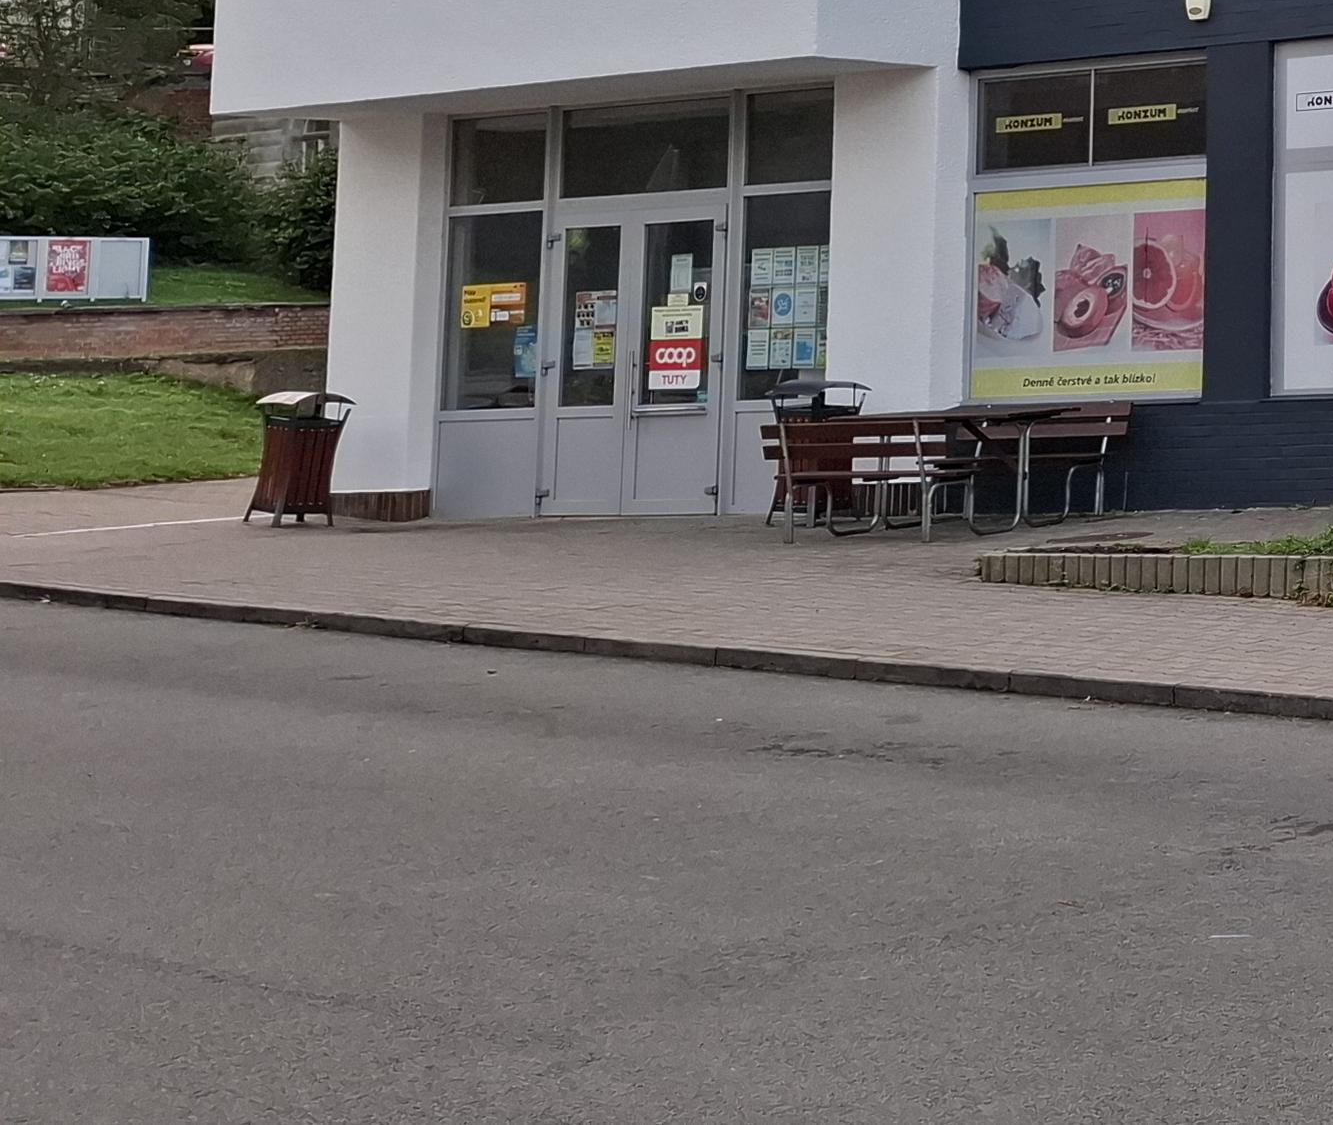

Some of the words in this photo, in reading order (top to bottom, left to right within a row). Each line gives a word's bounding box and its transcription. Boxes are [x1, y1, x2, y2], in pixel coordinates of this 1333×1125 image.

[1117, 108, 1167, 121] KONZUM
[1005, 117, 1053, 130] KONZUM
[655, 347, 696, 368] coop
[662, 374, 687, 385] TUTY
[1057, 375, 1092, 386] čerstvé
[1095, 376, 1101, 385] a
[1104, 374, 1120, 385] tak
